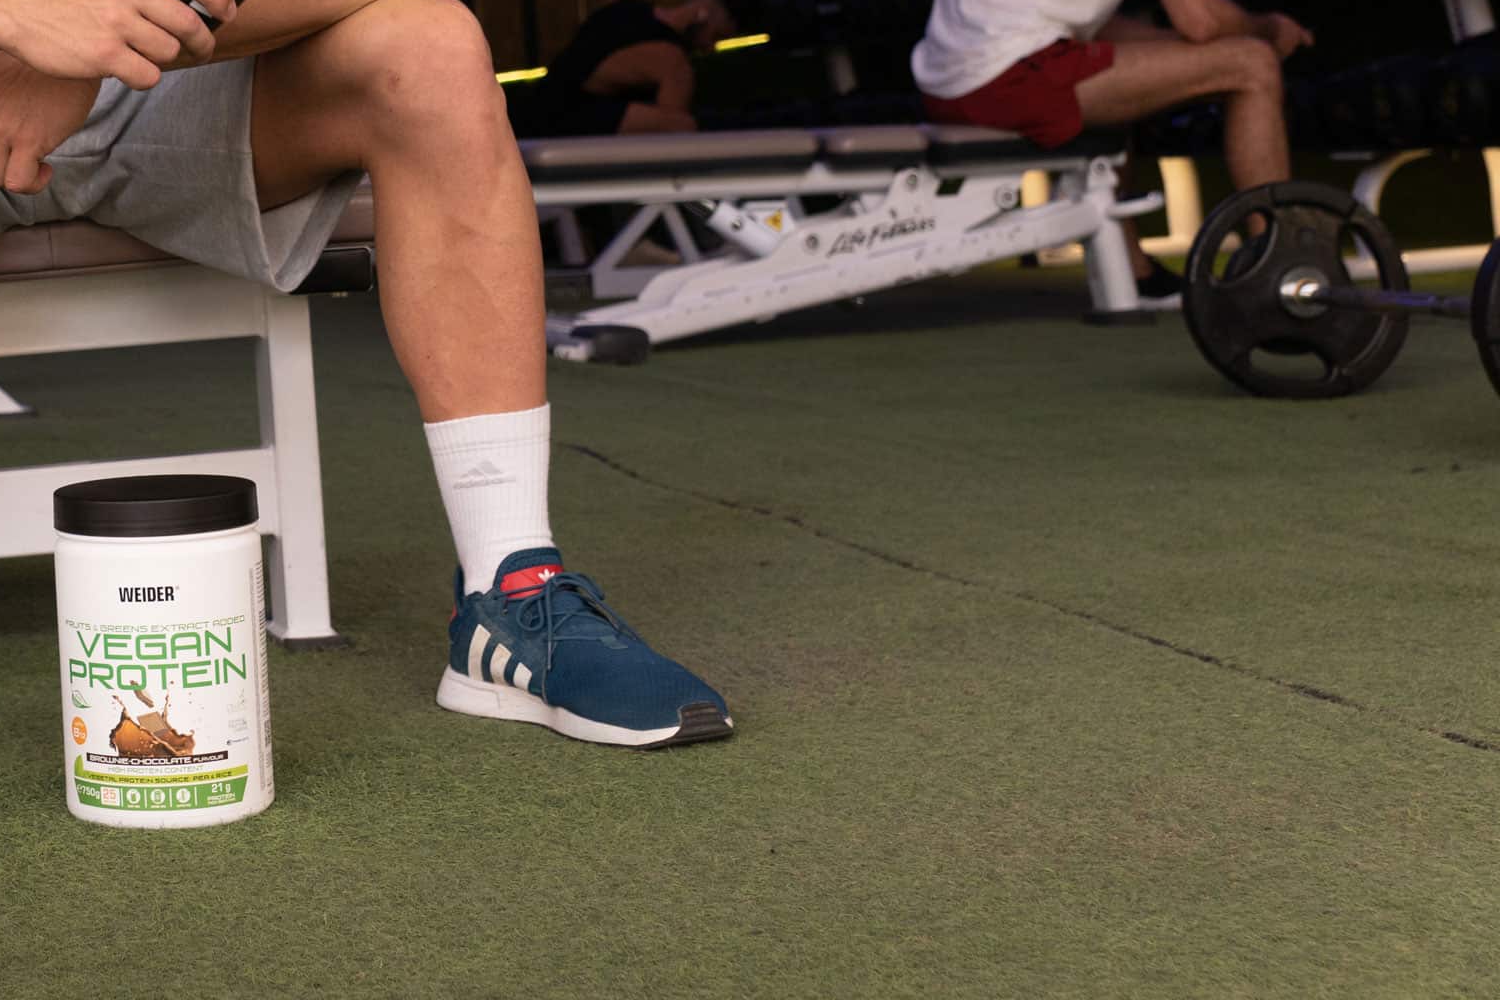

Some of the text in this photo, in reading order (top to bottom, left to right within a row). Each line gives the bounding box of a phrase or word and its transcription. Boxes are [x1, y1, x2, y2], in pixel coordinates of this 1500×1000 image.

[119, 586, 175, 603] WEIDER
[100, 624, 148, 633] GREENS
[150, 621, 209, 633] EXTRACT
[77, 627, 232, 660] VEGAN
[69, 653, 247, 691] PROTEIN
[211, 783, 223, 793] 21
